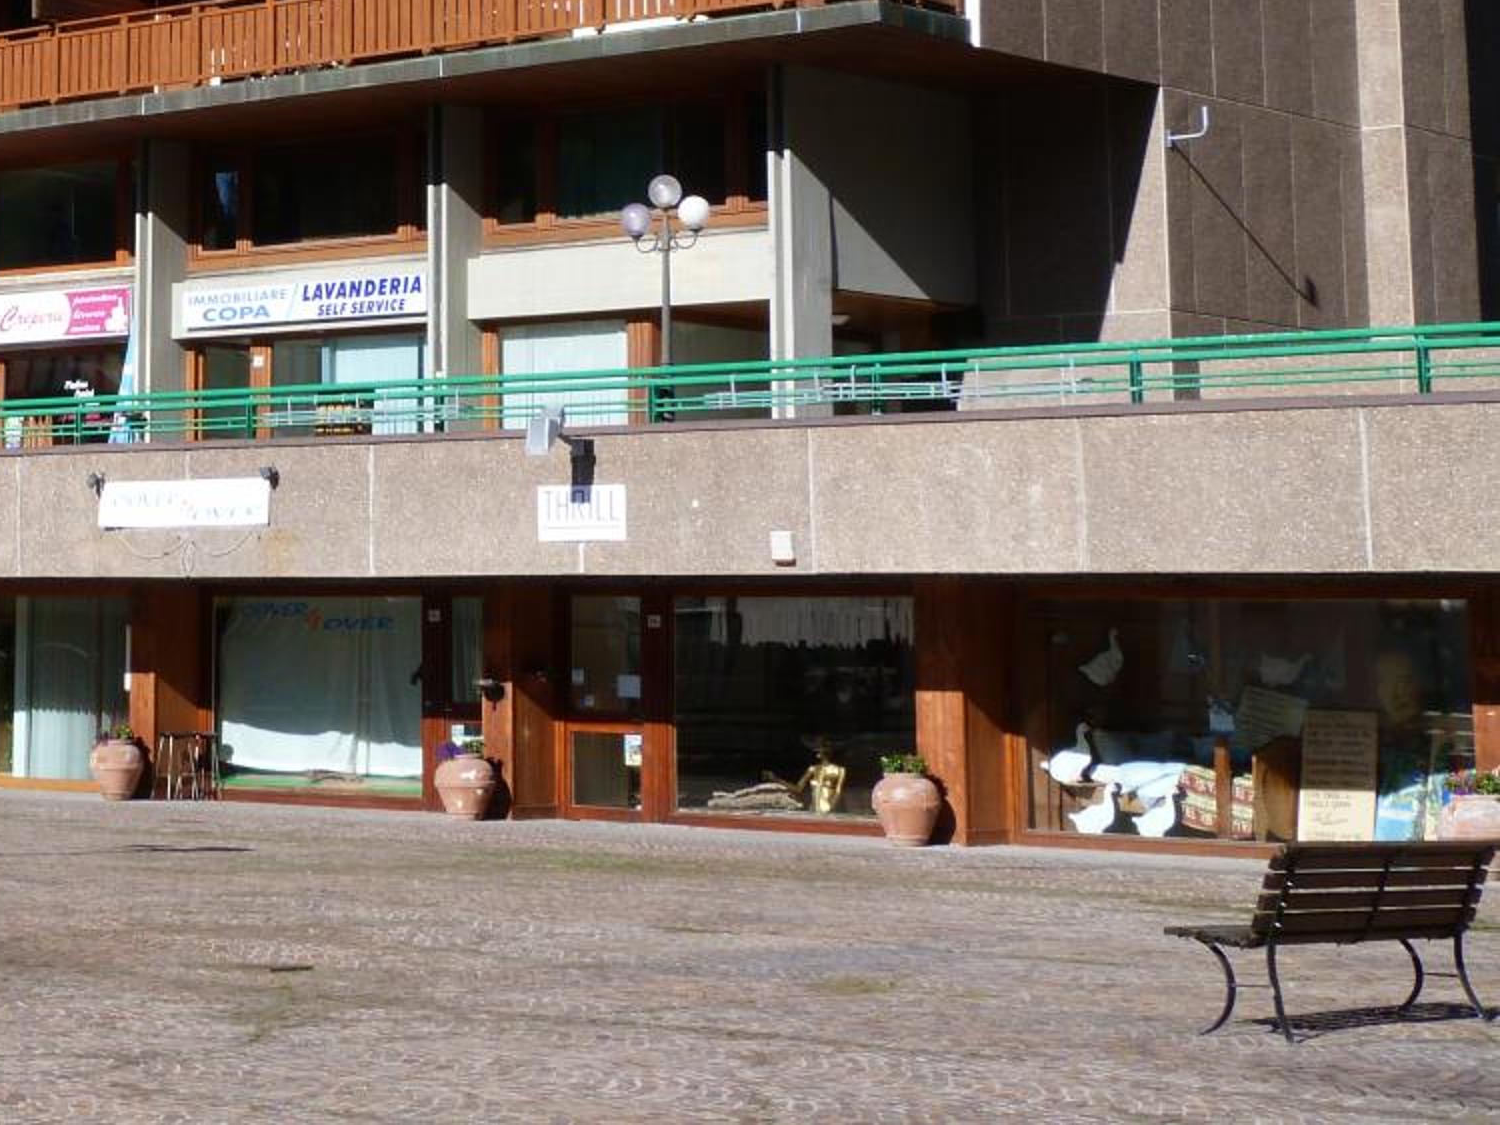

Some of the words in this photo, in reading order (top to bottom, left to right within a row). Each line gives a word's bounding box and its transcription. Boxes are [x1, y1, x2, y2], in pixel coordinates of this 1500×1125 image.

[188, 288, 288, 307] IMMOBILIARE
[302, 275, 422, 301] LAVANDERIA
[203, 304, 270, 322] COPA
[317, 302, 347, 317] SELF
[350, 298, 406, 315] SERVICE
[541, 490, 621, 522] THRILL
[324, 615, 394, 631] OVER
